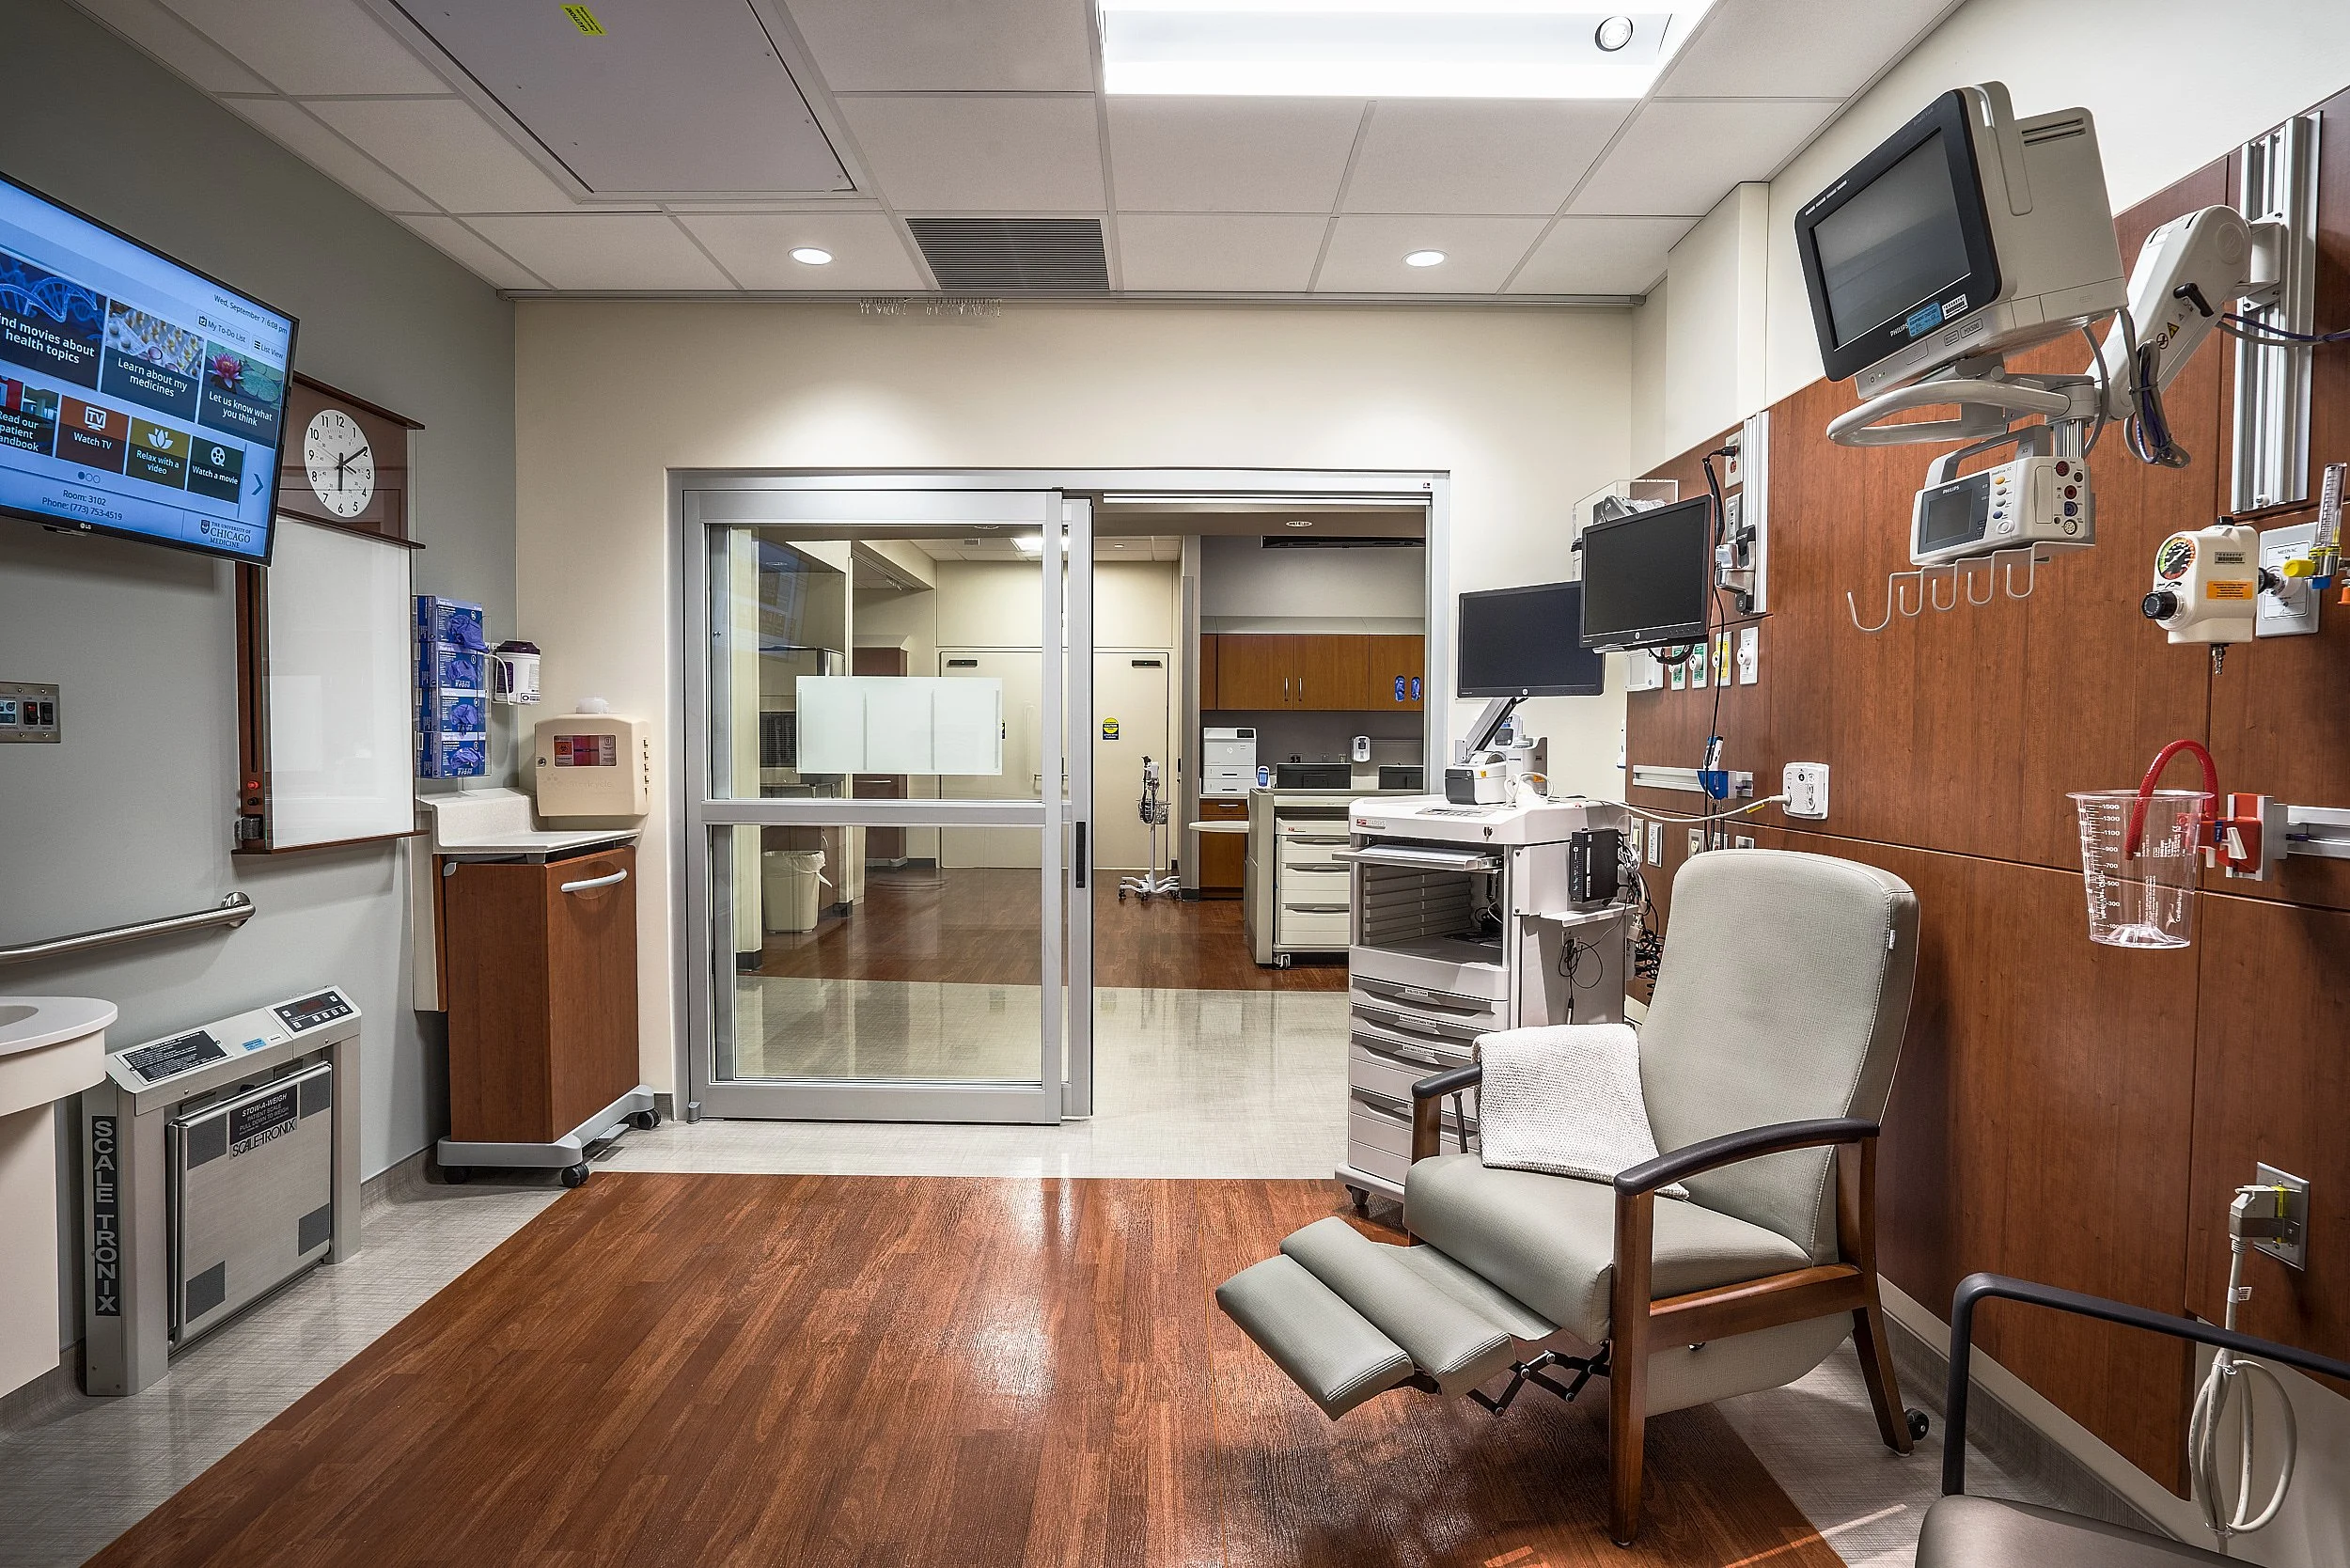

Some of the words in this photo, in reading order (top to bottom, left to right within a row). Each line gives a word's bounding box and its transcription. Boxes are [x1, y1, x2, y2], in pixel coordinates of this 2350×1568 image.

[214, 294, 228, 307] Wed,
[230, 303, 259, 321] September
[278, 326, 288, 335] pm
[0, 312, 17, 329] ind
[20, 322, 60, 344] movies
[62, 338, 95, 357] about
[208, 321, 216, 331] My
[218, 325, 235, 337] To-Do
[236, 333, 246, 343] List
[1889, 322, 1908, 337] PHILIPS
[6, 328, 43, 352] health
[46, 344, 80, 364] topics
[261, 344, 270, 353] List
[271, 348, 284, 359] View
[118, 356, 145, 376] Learn
[146, 368, 173, 385] about
[174, 379, 188, 393] my
[129, 375, 175, 398] medicines
[209, 390, 223, 404] Let
[223, 397, 232, 407] us
[232, 399, 254, 415] know
[254, 408, 273, 421] what
[22, 418, 39, 429] our
[87, 411, 103, 425] TV
[222, 407, 237, 420] you
[238, 411, 258, 427] think
[321, 415, 329, 428] 11
[336, 415, 345, 428] 12
[0, 423, 34, 439] patient
[309, 427, 320, 440] 10
[352, 427, 356, 438] 1
[0, 433, 39, 452] andbook
[73, 431, 100, 447] Watch
[101, 440, 112, 449] TV
[136, 449, 157, 463] Relax
[157, 457, 174, 467] with
[308, 449, 315, 460] 9
[147, 463, 167, 475] video
[192, 465, 212, 478] Watch
[218, 474, 239, 485] movie
[311, 471, 318, 482] 8
[366, 469, 370, 479] 3
[63, 489, 86, 501] Room:
[88, 496, 106, 506] 3102
[362, 487, 368, 497] 4
[1942, 485, 1960, 494] PHILIPS
[322, 493, 328, 503] 7
[352, 501, 358, 511] 5
[41, 496, 69, 510] Phone:
[70, 502, 89, 514] (773)
[90, 506, 123, 521] 753-4519
[337, 503, 343, 513] 6
[210, 525, 251, 544] CHICAGO
[209, 538, 240, 549] MEDICINE
[247, 1109, 266, 1121] PATIENT
[267, 1104, 281, 1114] SCALE
[252, 1115, 267, 1126] DOWN
[274, 1106, 290, 1116] WEIGH
[95, 1120, 115, 1202] SCALE
[95, 1214, 118, 1311] TRONIX
